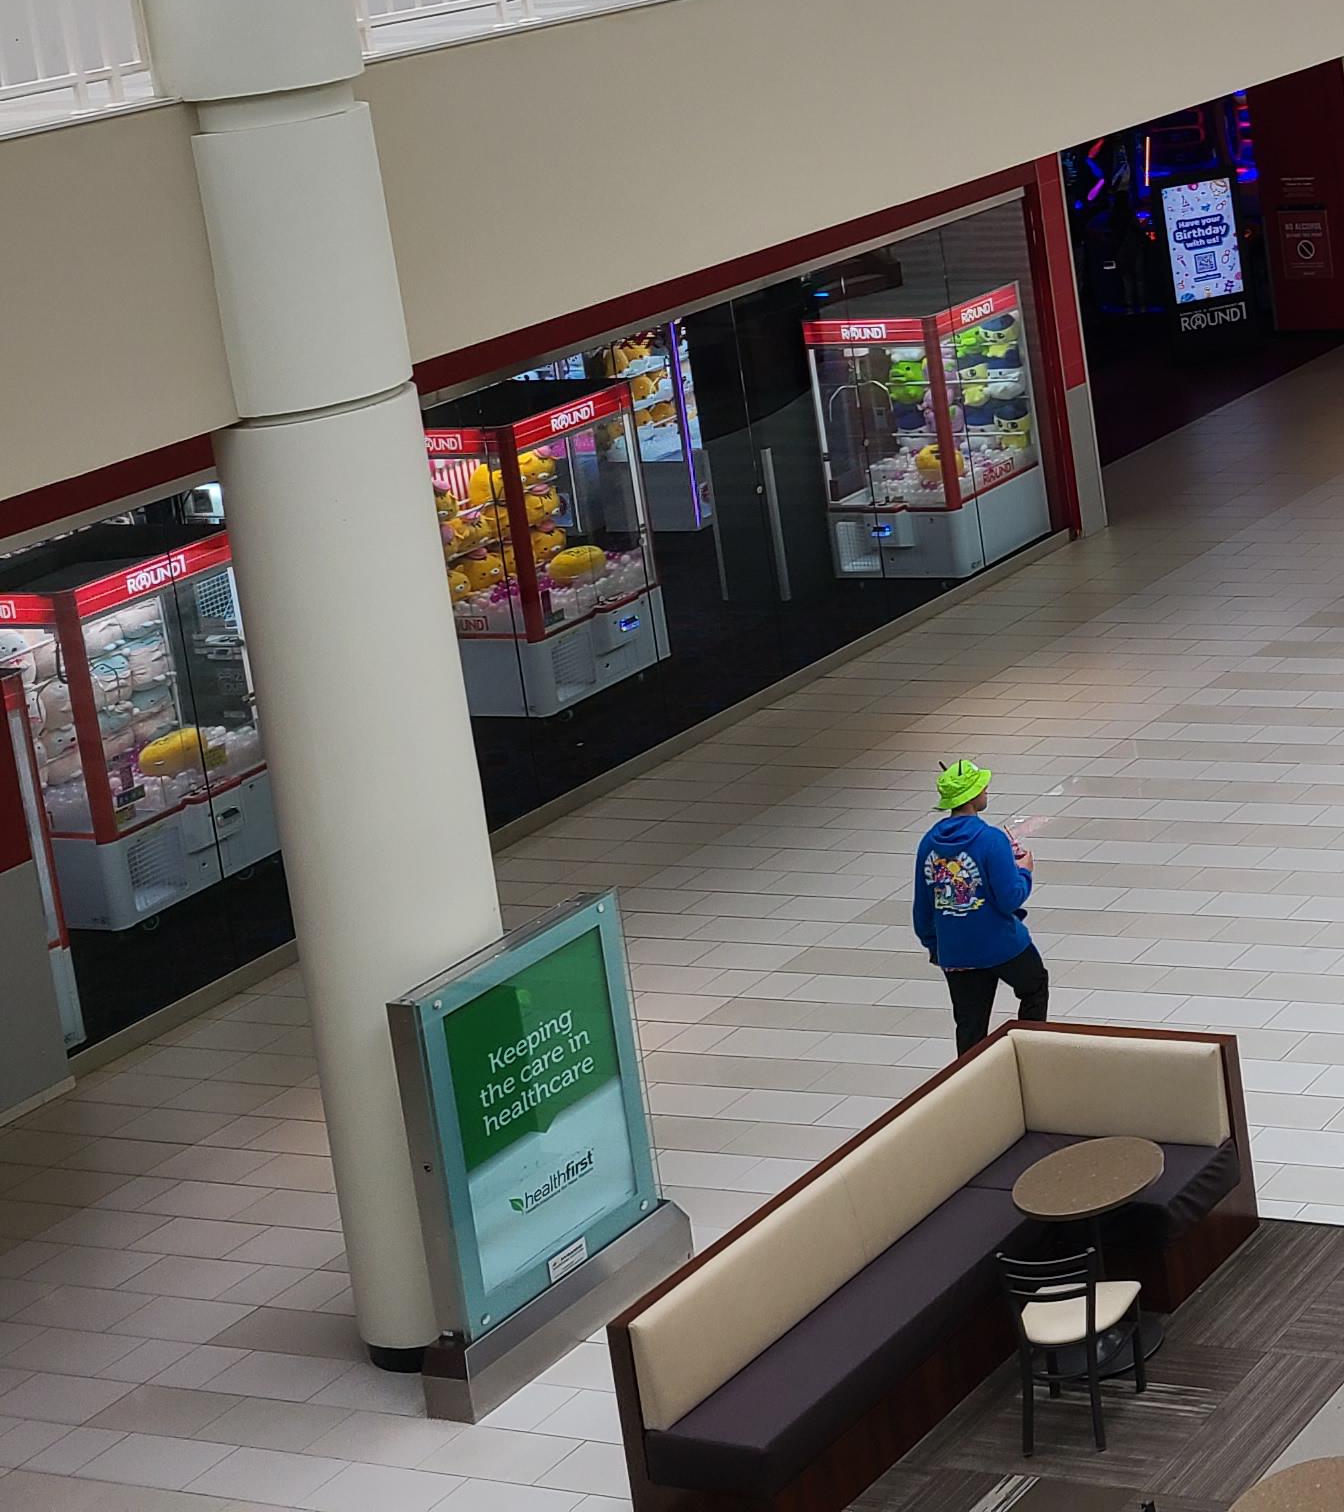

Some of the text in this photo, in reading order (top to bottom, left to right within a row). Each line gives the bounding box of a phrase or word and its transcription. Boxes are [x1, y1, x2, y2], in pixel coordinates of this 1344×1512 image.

[1174, 224, 1228, 242] Birthday
[1178, 214, 1222, 229] Have your
[1185, 235, 1220, 249] with us!
[962, 298, 993, 324] ROUND1
[1180, 302, 1247, 332] ROUND1
[841, 324, 886, 340] ROUND1
[551, 400, 595, 432] ROUND1
[425, 434, 463, 451] OUND1
[126, 553, 187, 594] ROUND1
[488, 1009, 572, 1073] Keeping
[480, 1029, 591, 1108] the care in
[483, 1056, 595, 1137] healthcare
[525, 1150, 594, 1209] healthfirst
